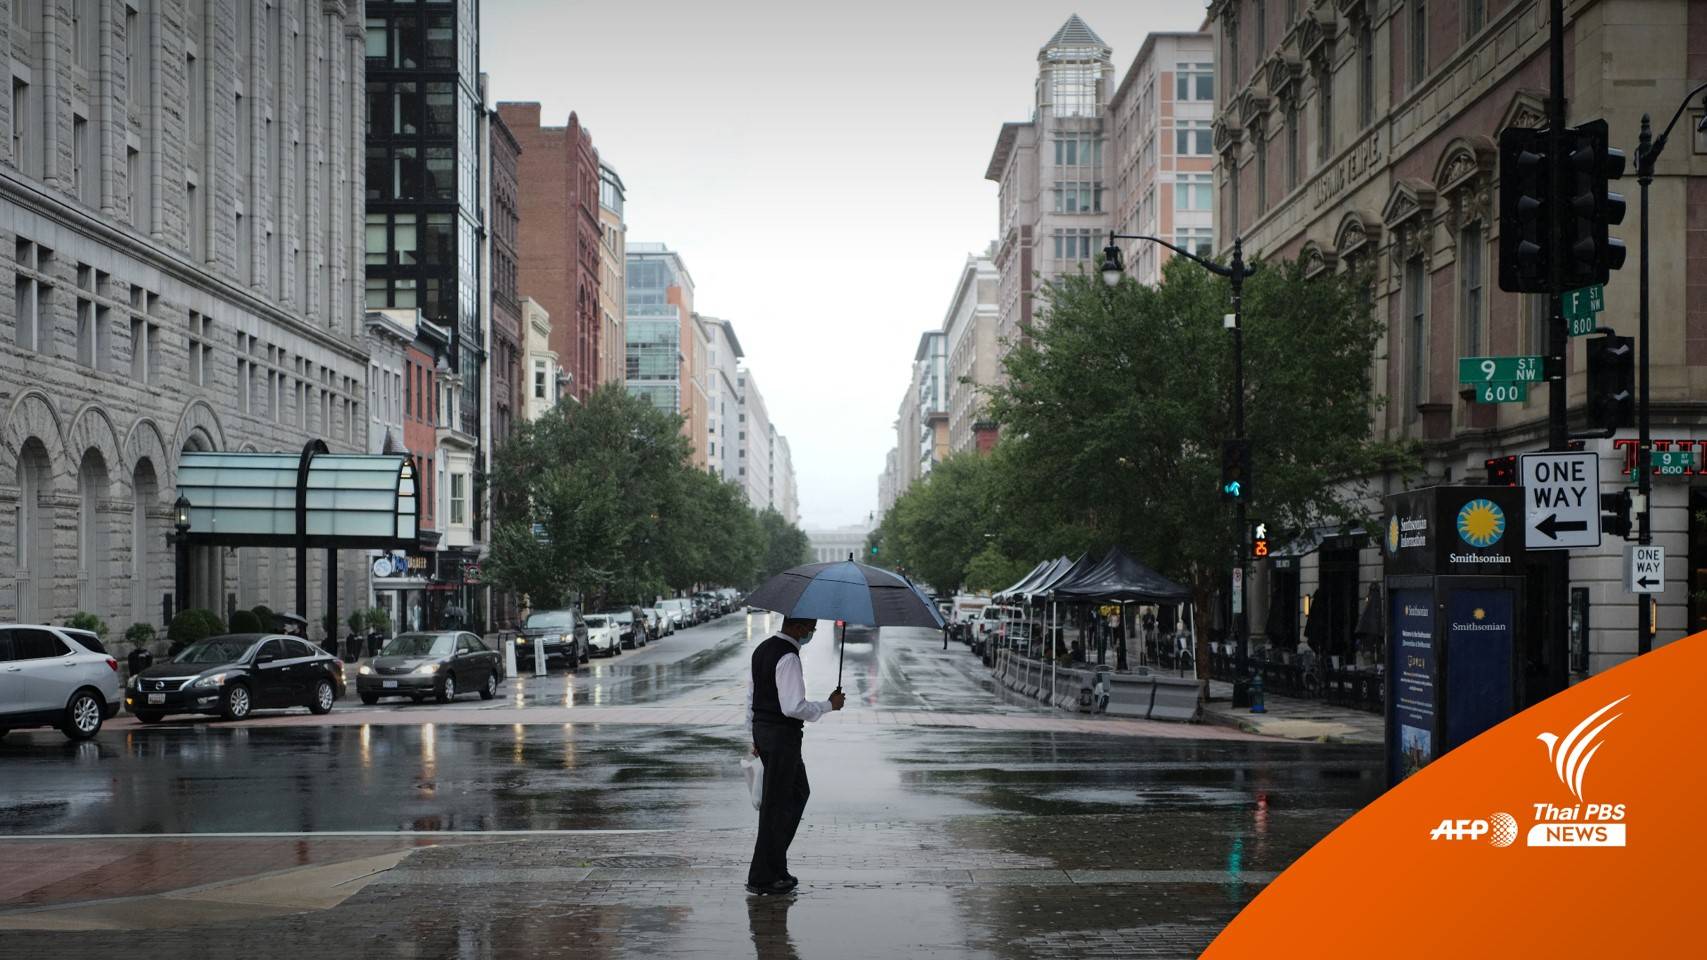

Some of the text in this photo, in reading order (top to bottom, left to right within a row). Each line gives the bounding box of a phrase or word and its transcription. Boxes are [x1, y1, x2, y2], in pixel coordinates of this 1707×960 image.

[1572, 287, 1598, 314] F ST
[1590, 298, 1601, 311] NW
[1573, 317, 1592, 334] 800
[1481, 358, 1535, 381] 9 ST
[1516, 369, 1535, 380] NW
[1485, 386, 1518, 401] 600
[1662, 453, 1672, 465] 9
[1535, 461, 1585, 483] ONE
[1661, 465, 1682, 474] 600
[1534, 487, 1588, 508] WAY
[1449, 552, 1511, 564] Smithsonian
[1637, 549, 1660, 561] ONE
[1636, 562, 1660, 573] WAY
[1452, 622, 1506, 632] Smithsonian
